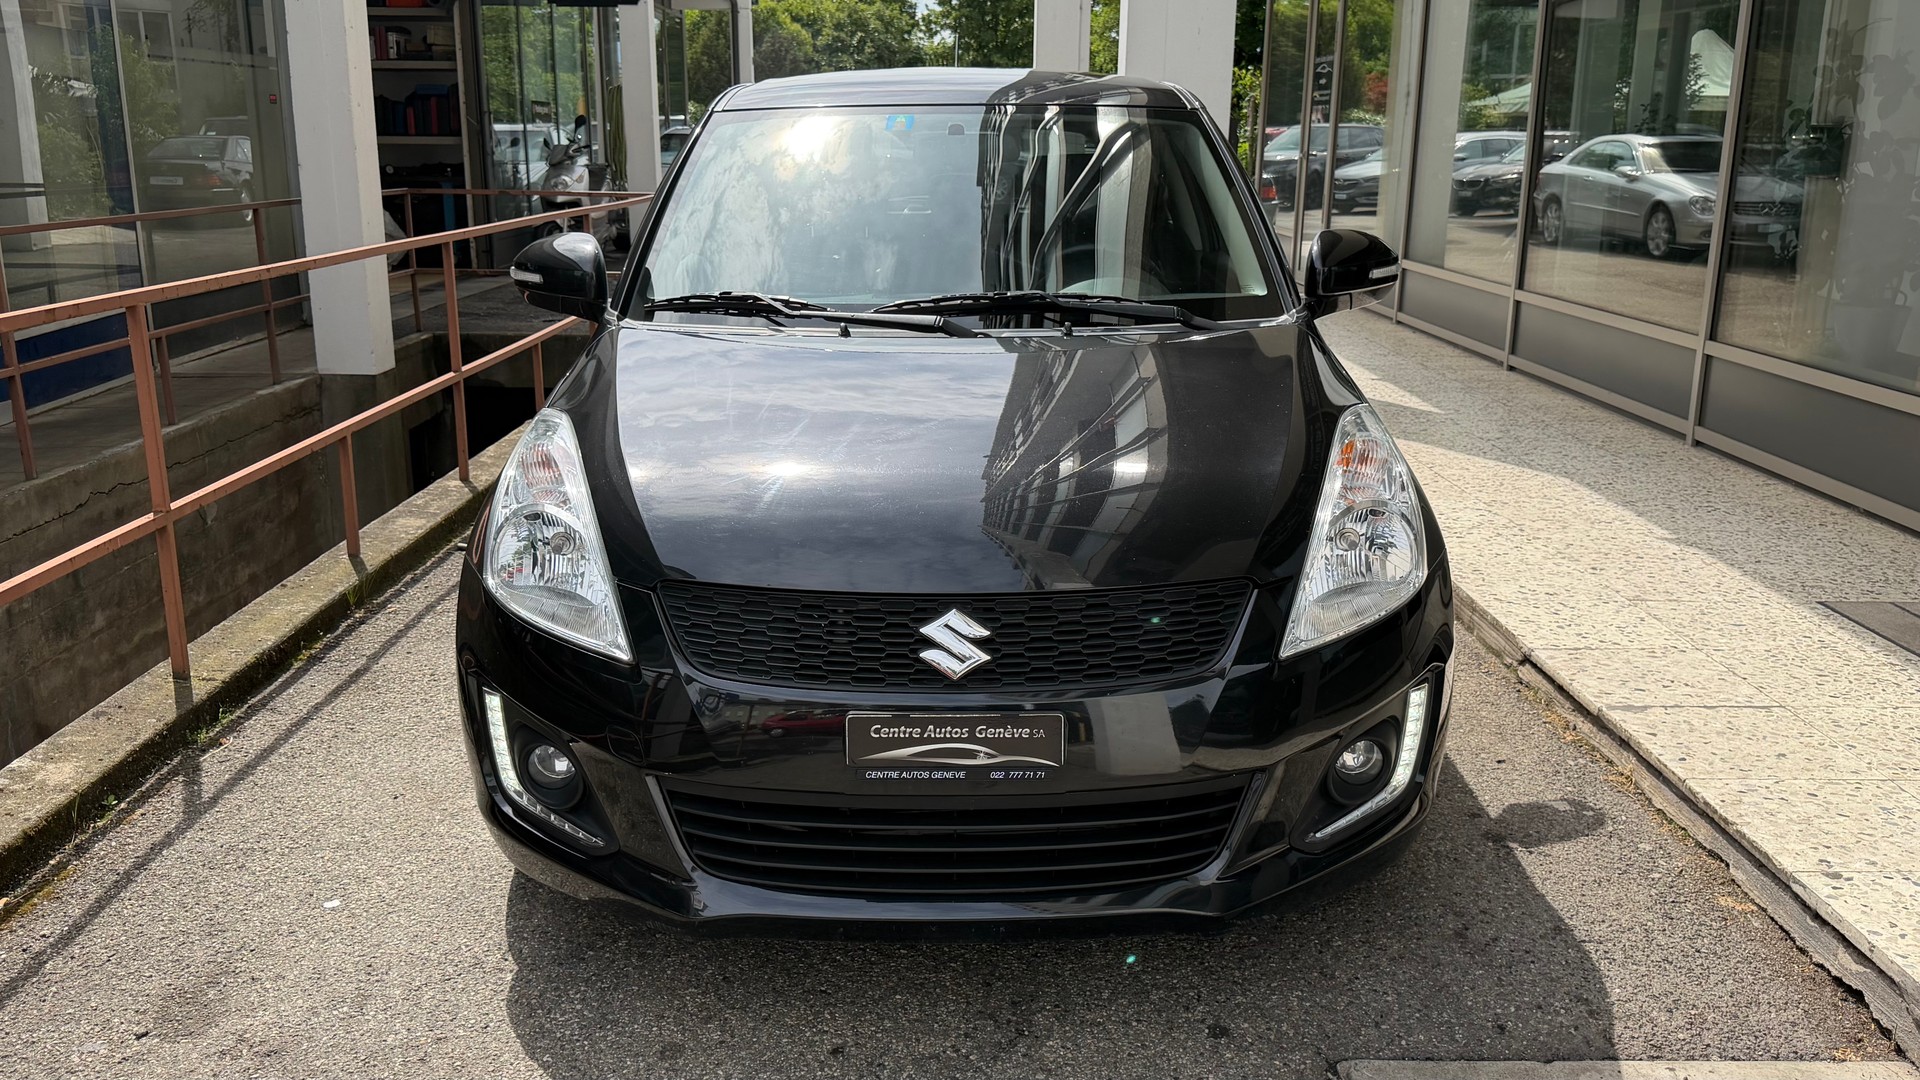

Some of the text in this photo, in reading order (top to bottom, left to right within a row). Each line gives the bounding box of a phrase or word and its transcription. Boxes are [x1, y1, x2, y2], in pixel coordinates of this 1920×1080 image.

[870, 724, 1046, 738] Centre Autos Genève SA
[865, 771, 1045, 779] CENTRE AUTOS GENEVE 022 777 71 71
